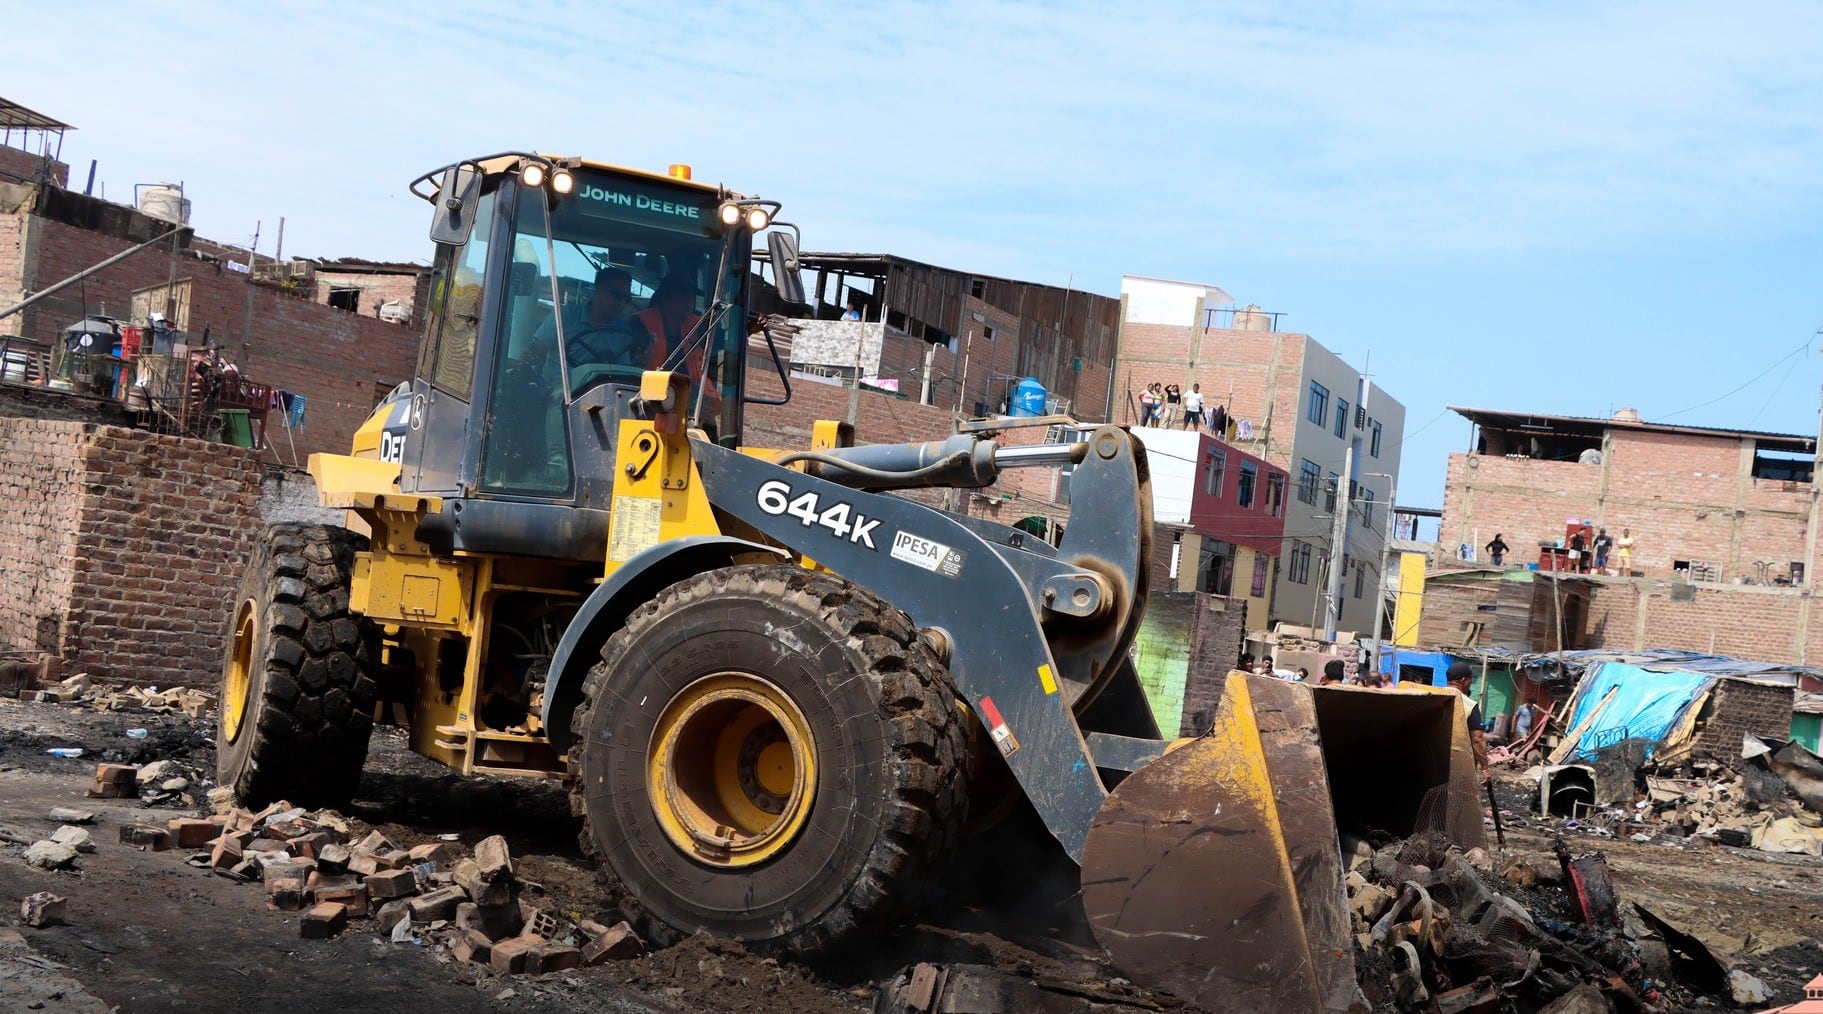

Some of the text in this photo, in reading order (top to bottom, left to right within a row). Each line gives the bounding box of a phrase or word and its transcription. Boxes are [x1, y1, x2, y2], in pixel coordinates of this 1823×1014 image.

[580, 185, 700, 218] JOHN DEERE
[757, 480, 881, 549] 644K
[896, 534, 938, 560] IPESA
